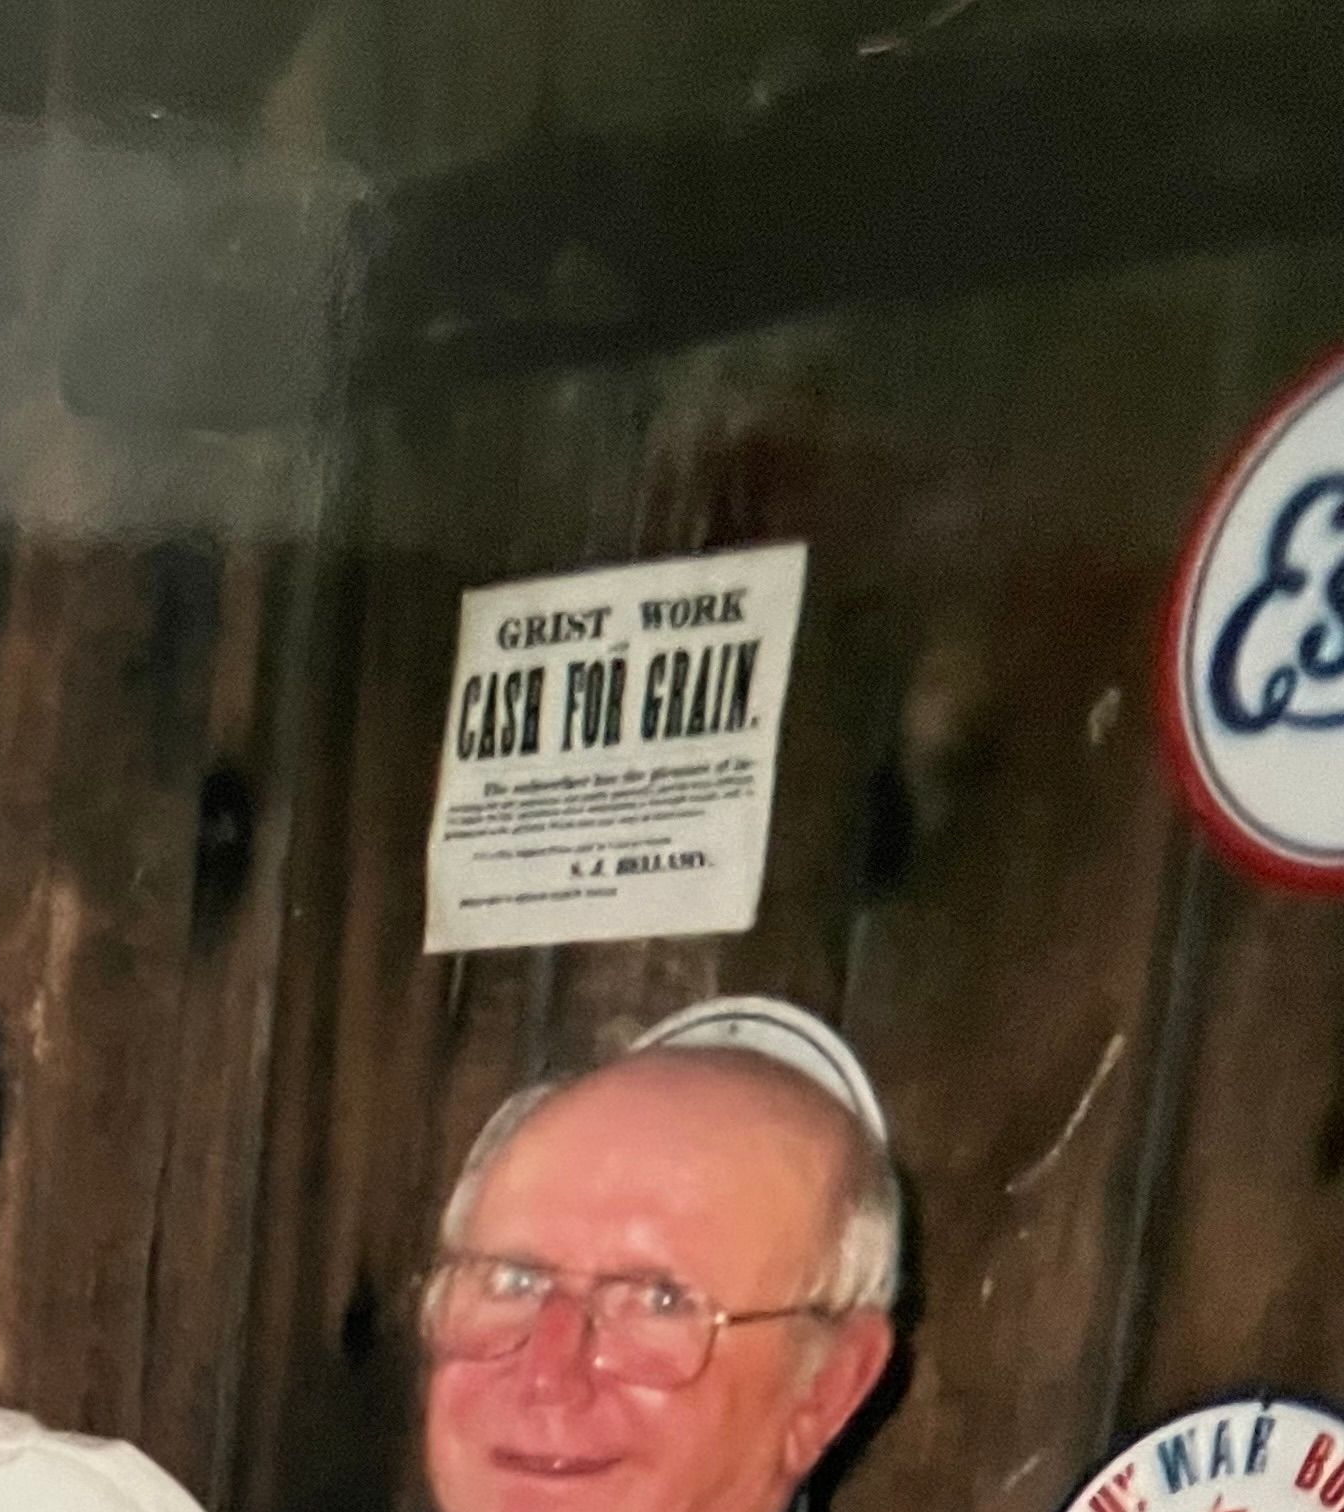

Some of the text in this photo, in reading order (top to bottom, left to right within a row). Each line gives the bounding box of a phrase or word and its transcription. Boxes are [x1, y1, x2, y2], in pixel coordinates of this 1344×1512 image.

[497, 589, 747, 651] GRIST WORK
[457, 667, 545, 761] CASH
[562, 658, 627, 752] FOR
[1157, 1415, 1276, 1494] WAR
